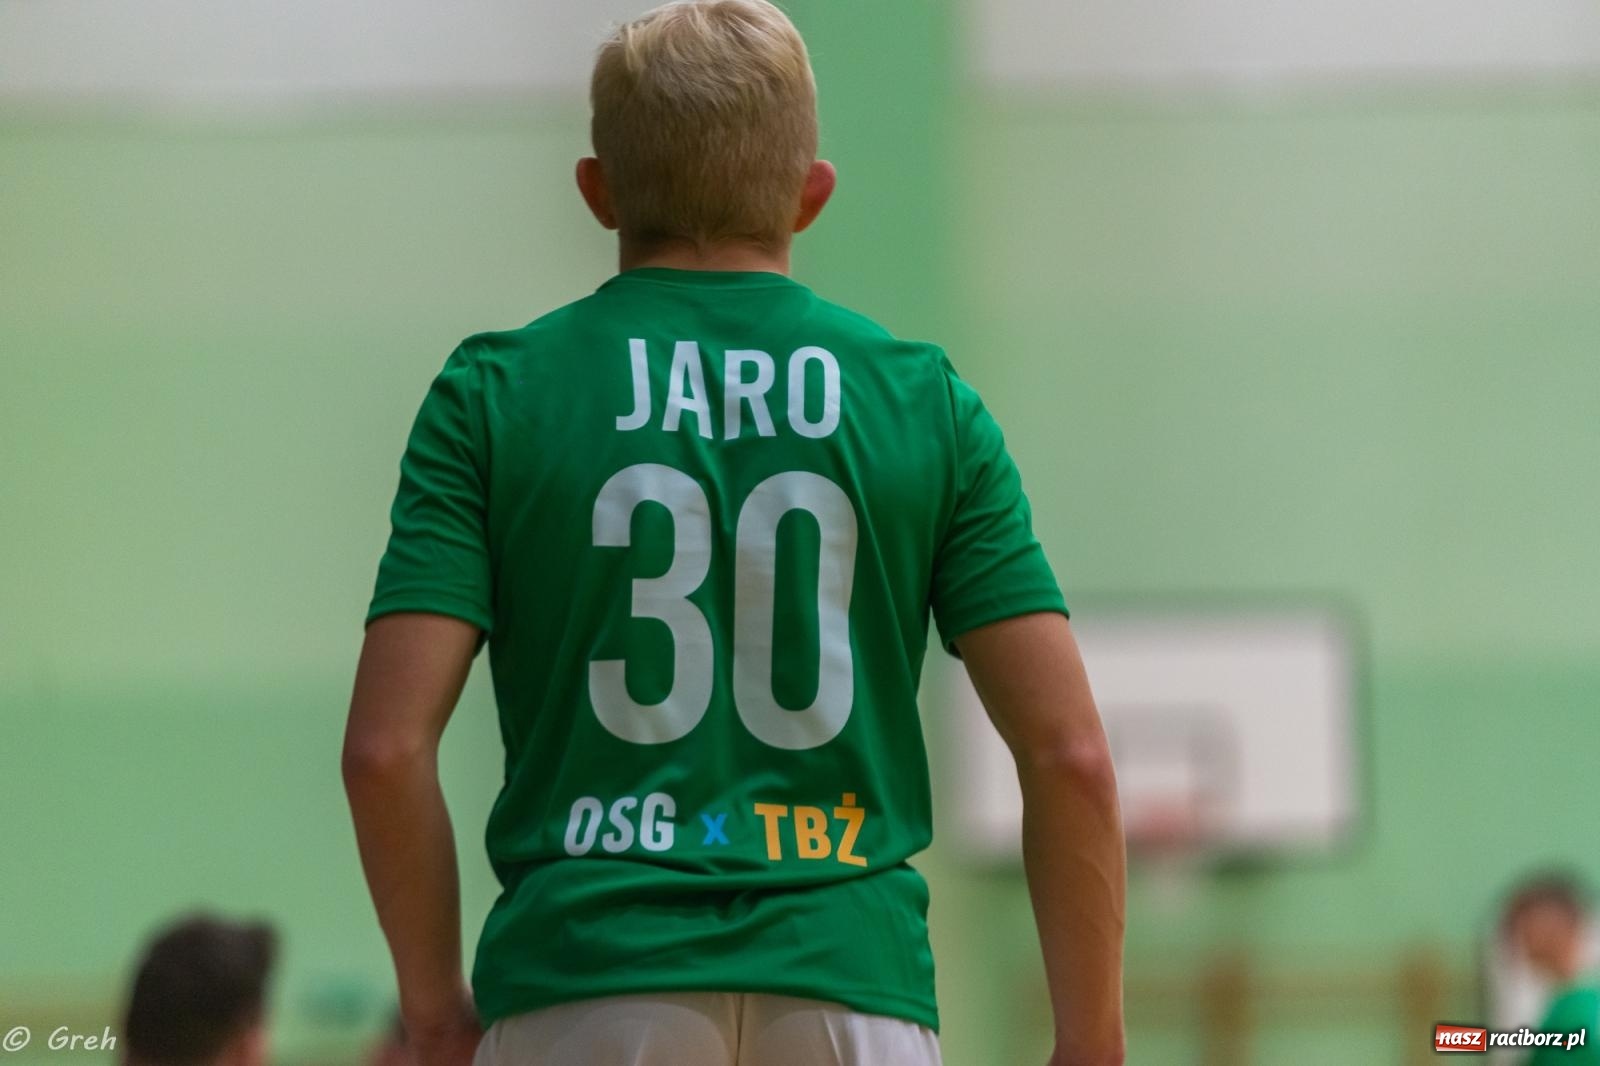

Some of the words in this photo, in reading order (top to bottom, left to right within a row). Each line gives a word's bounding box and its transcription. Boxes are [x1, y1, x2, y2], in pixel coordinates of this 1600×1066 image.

[615, 338, 841, 440] JARO
[588, 463, 858, 750] 30
[563, 792, 676, 856] OSG
[753, 793, 868, 867] TBŻ
